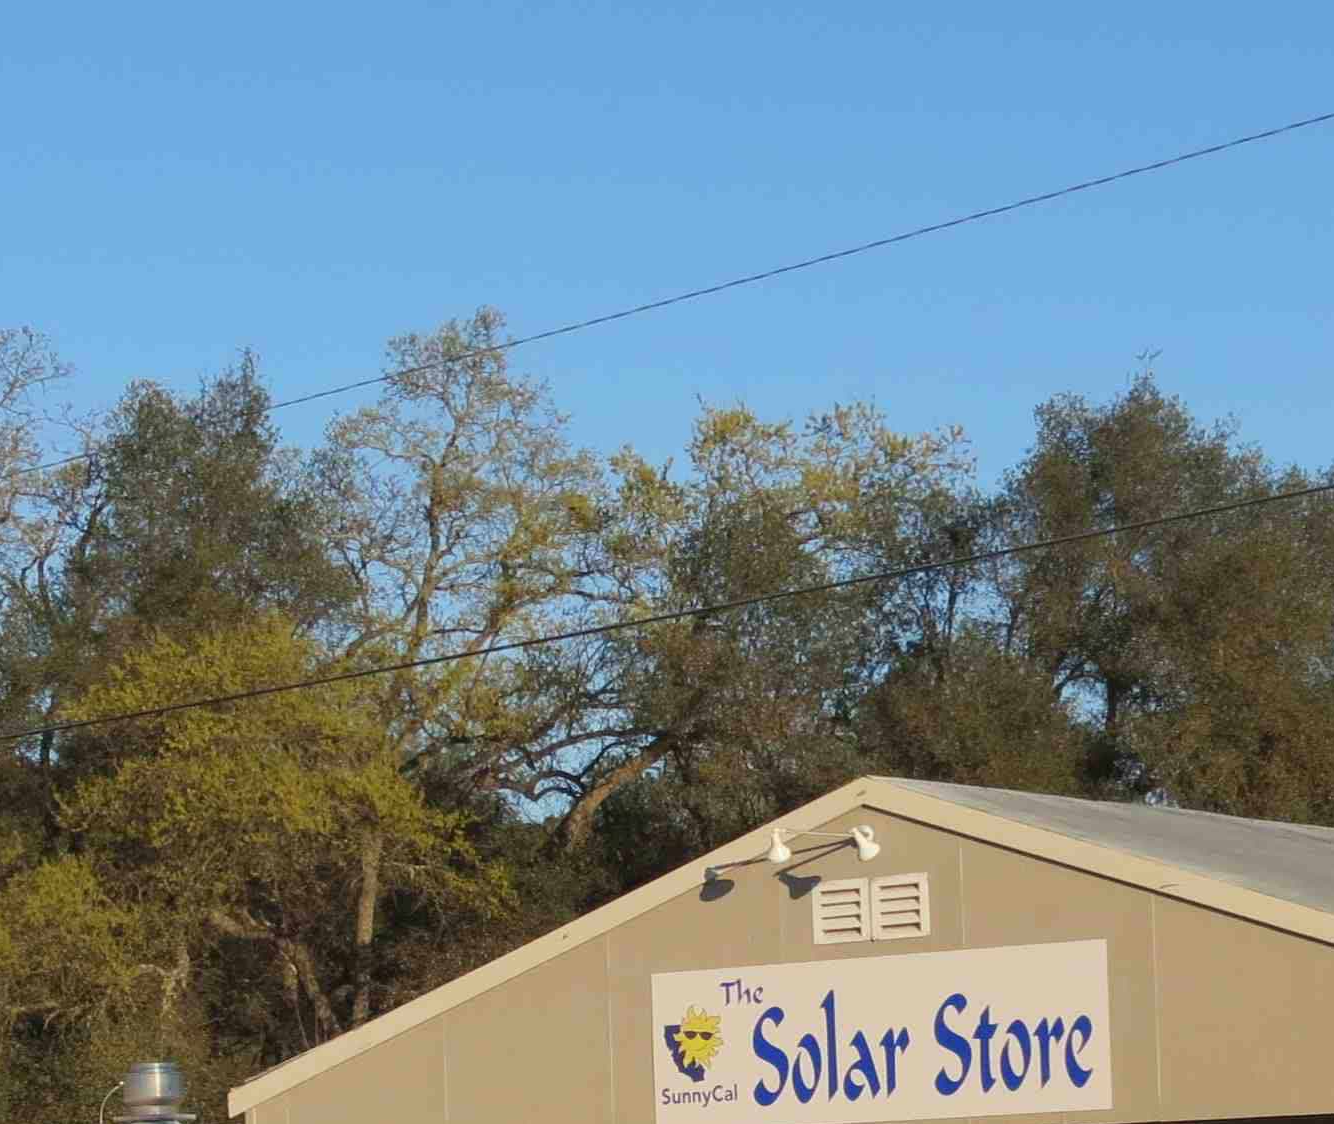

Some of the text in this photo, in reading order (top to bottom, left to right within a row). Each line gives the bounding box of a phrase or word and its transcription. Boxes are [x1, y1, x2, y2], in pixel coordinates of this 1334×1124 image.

[720, 977, 764, 1007] The
[752, 989, 1093, 1106] Solar Store
[661, 1083, 739, 1108] SunnyCal
